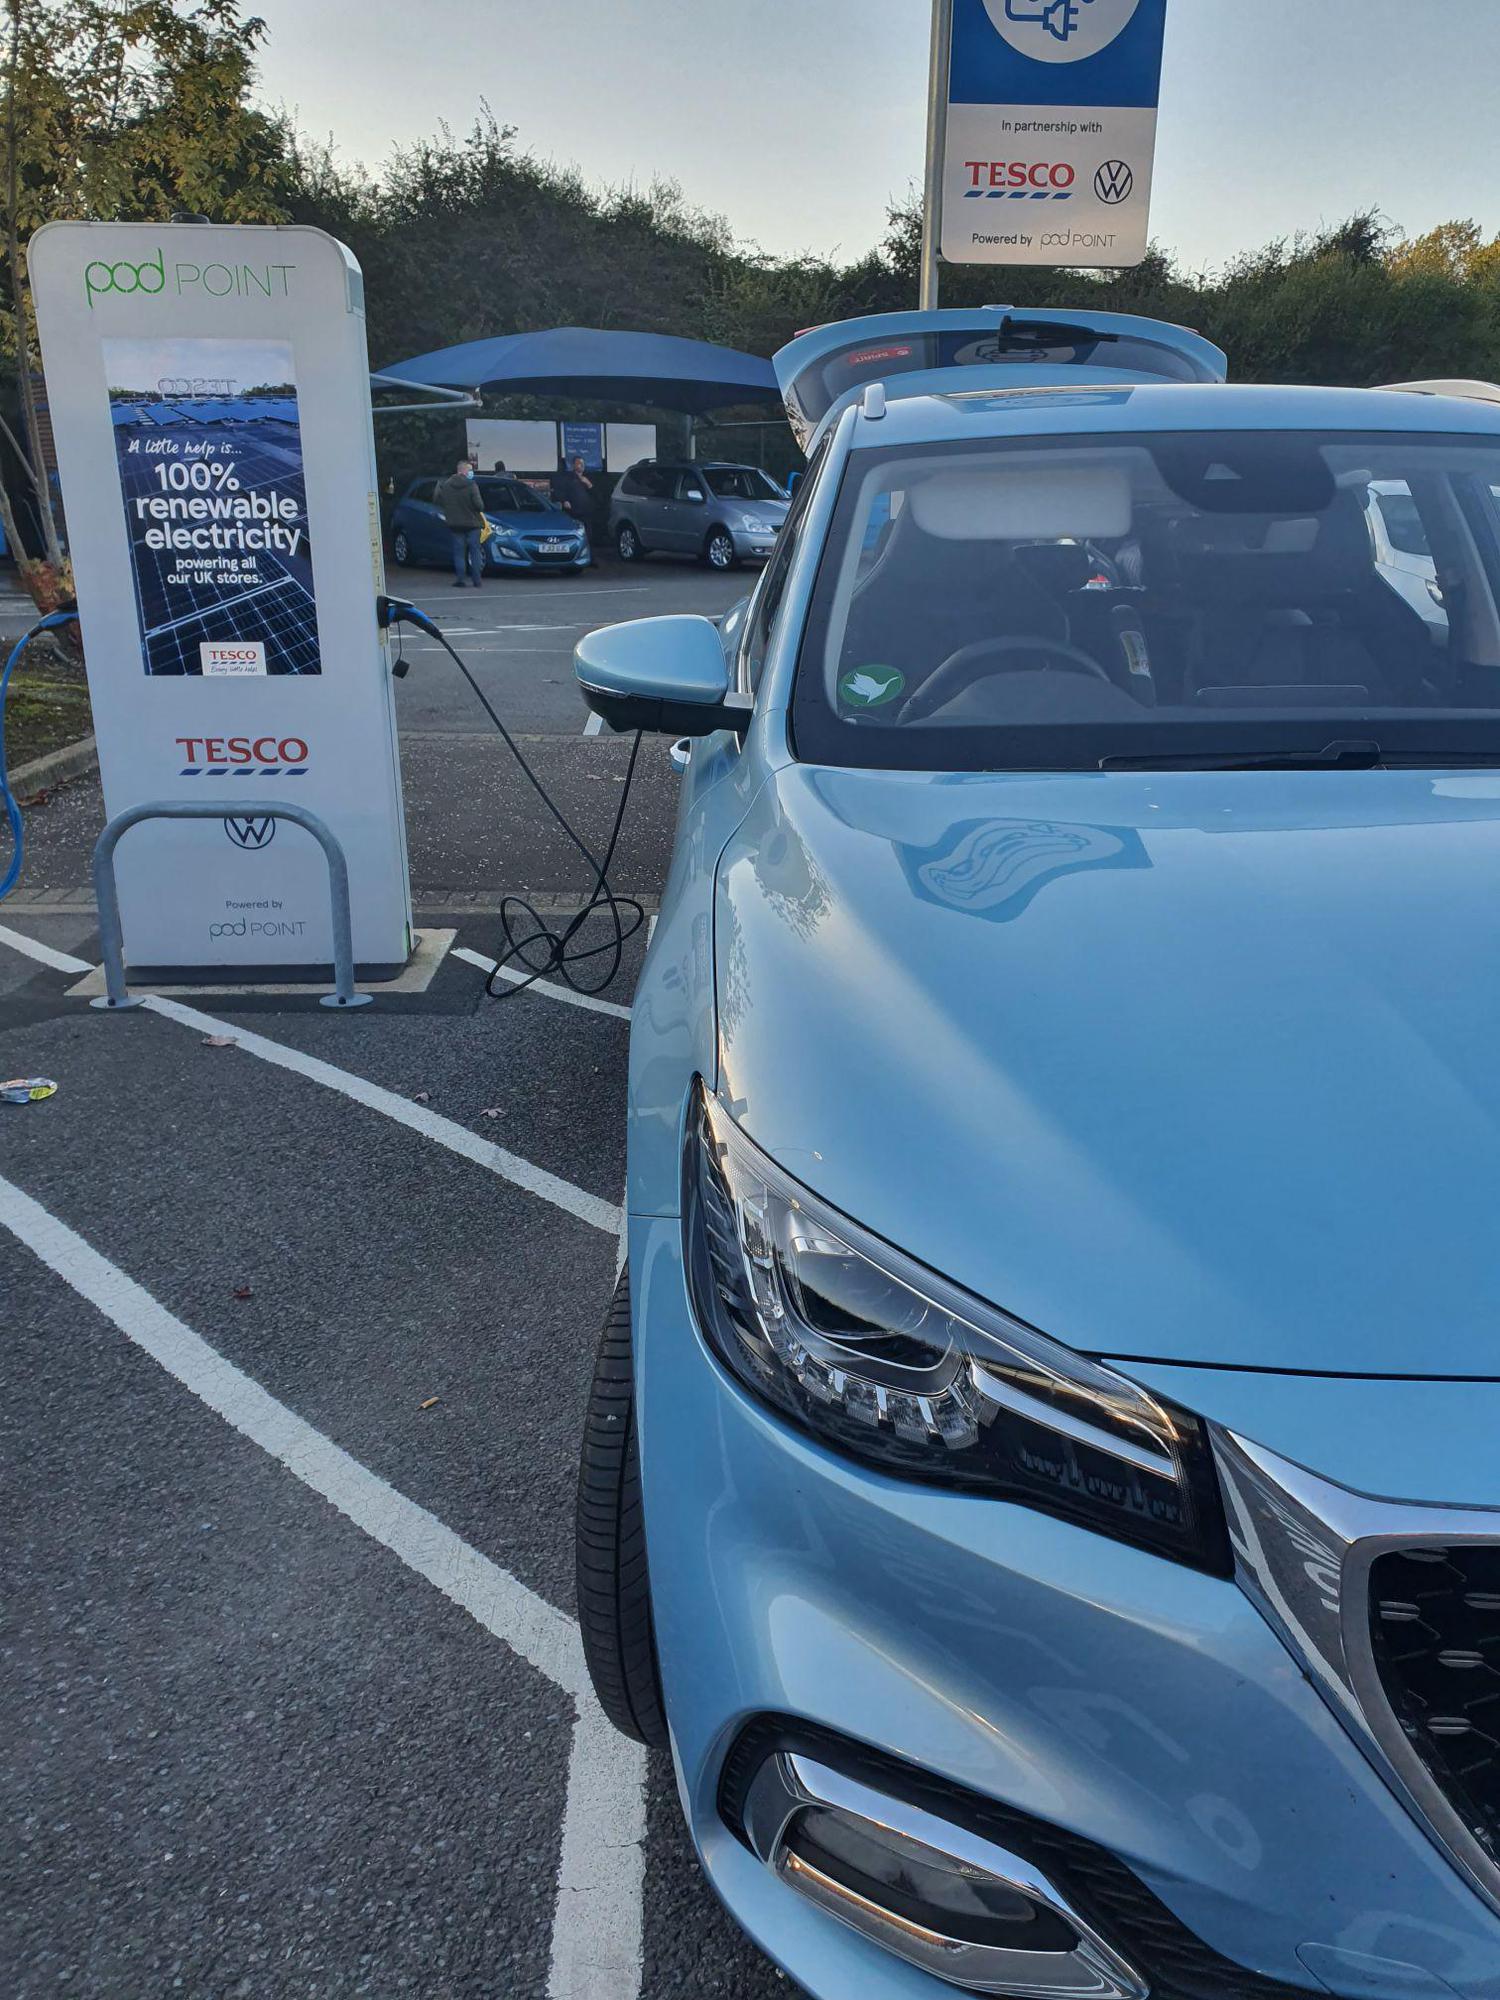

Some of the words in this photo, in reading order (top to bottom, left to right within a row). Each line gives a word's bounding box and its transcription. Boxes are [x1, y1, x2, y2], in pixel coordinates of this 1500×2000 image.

[1001, 119, 1011, 132] In
[1014, 120, 1077, 135] partnership
[1079, 121, 1102, 133] with
[964, 161, 1075, 188] TESCO
[972, 232, 1017, 246] Powered
[1020, 233, 1032, 248] by
[1040, 228, 1070, 250] pod
[1073, 234, 1116, 248] POINT
[85, 248, 165, 310] pod
[175, 263, 297, 297] POINT
[127, 438, 140, 454] A
[145, 438, 180, 455] little
[184, 440, 215, 460] help
[154, 461, 240, 491] 100%
[136, 490, 298, 519] renewable
[144, 521, 301, 556] electricity
[176, 556, 239, 572] powering
[241, 556, 256, 570] all
[167, 573, 191, 585] our
[193, 572, 215, 585] UK
[216, 572, 263, 585] stores.
[209, 650, 257, 661] TESCO
[175, 737, 309, 764] TESCO
[225, 900, 269, 910] Powered
[271, 900, 283, 911] by
[209, 917, 246, 943] pod
[250, 921, 307, 937] POINT
